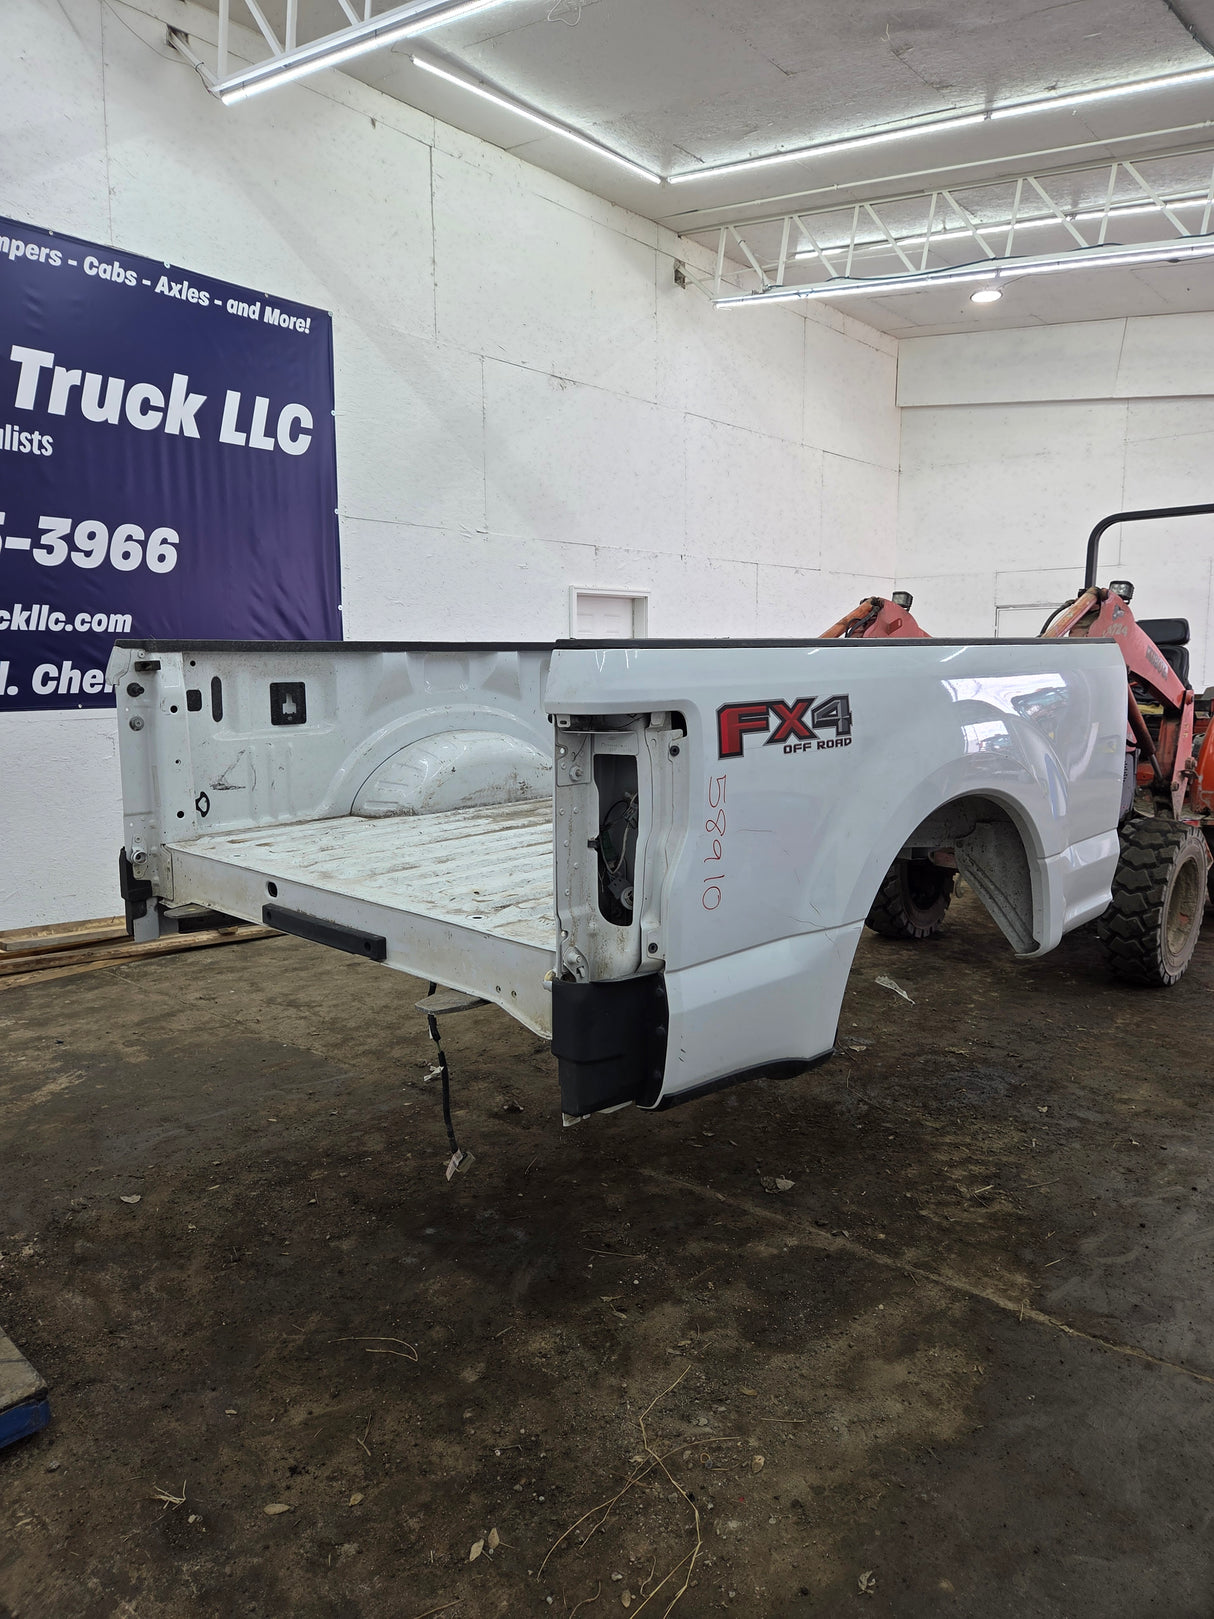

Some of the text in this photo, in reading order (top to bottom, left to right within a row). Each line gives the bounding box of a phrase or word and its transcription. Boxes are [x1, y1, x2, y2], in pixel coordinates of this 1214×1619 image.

[83, 255, 137, 287] Cabs
[154, 275, 210, 307] Axles
[226, 298, 260, 320] and
[263, 306, 311, 334] More!
[10, 345, 314, 456] Truck LLC
[0, 511, 180, 574] -3966
[0, 603, 132, 633] ckllc.com
[32, 661, 114, 695] Che
[715, 693, 853, 760] FX4
[783, 737, 853, 754] OFF ROAD
[702, 774, 727, 910] 58910
